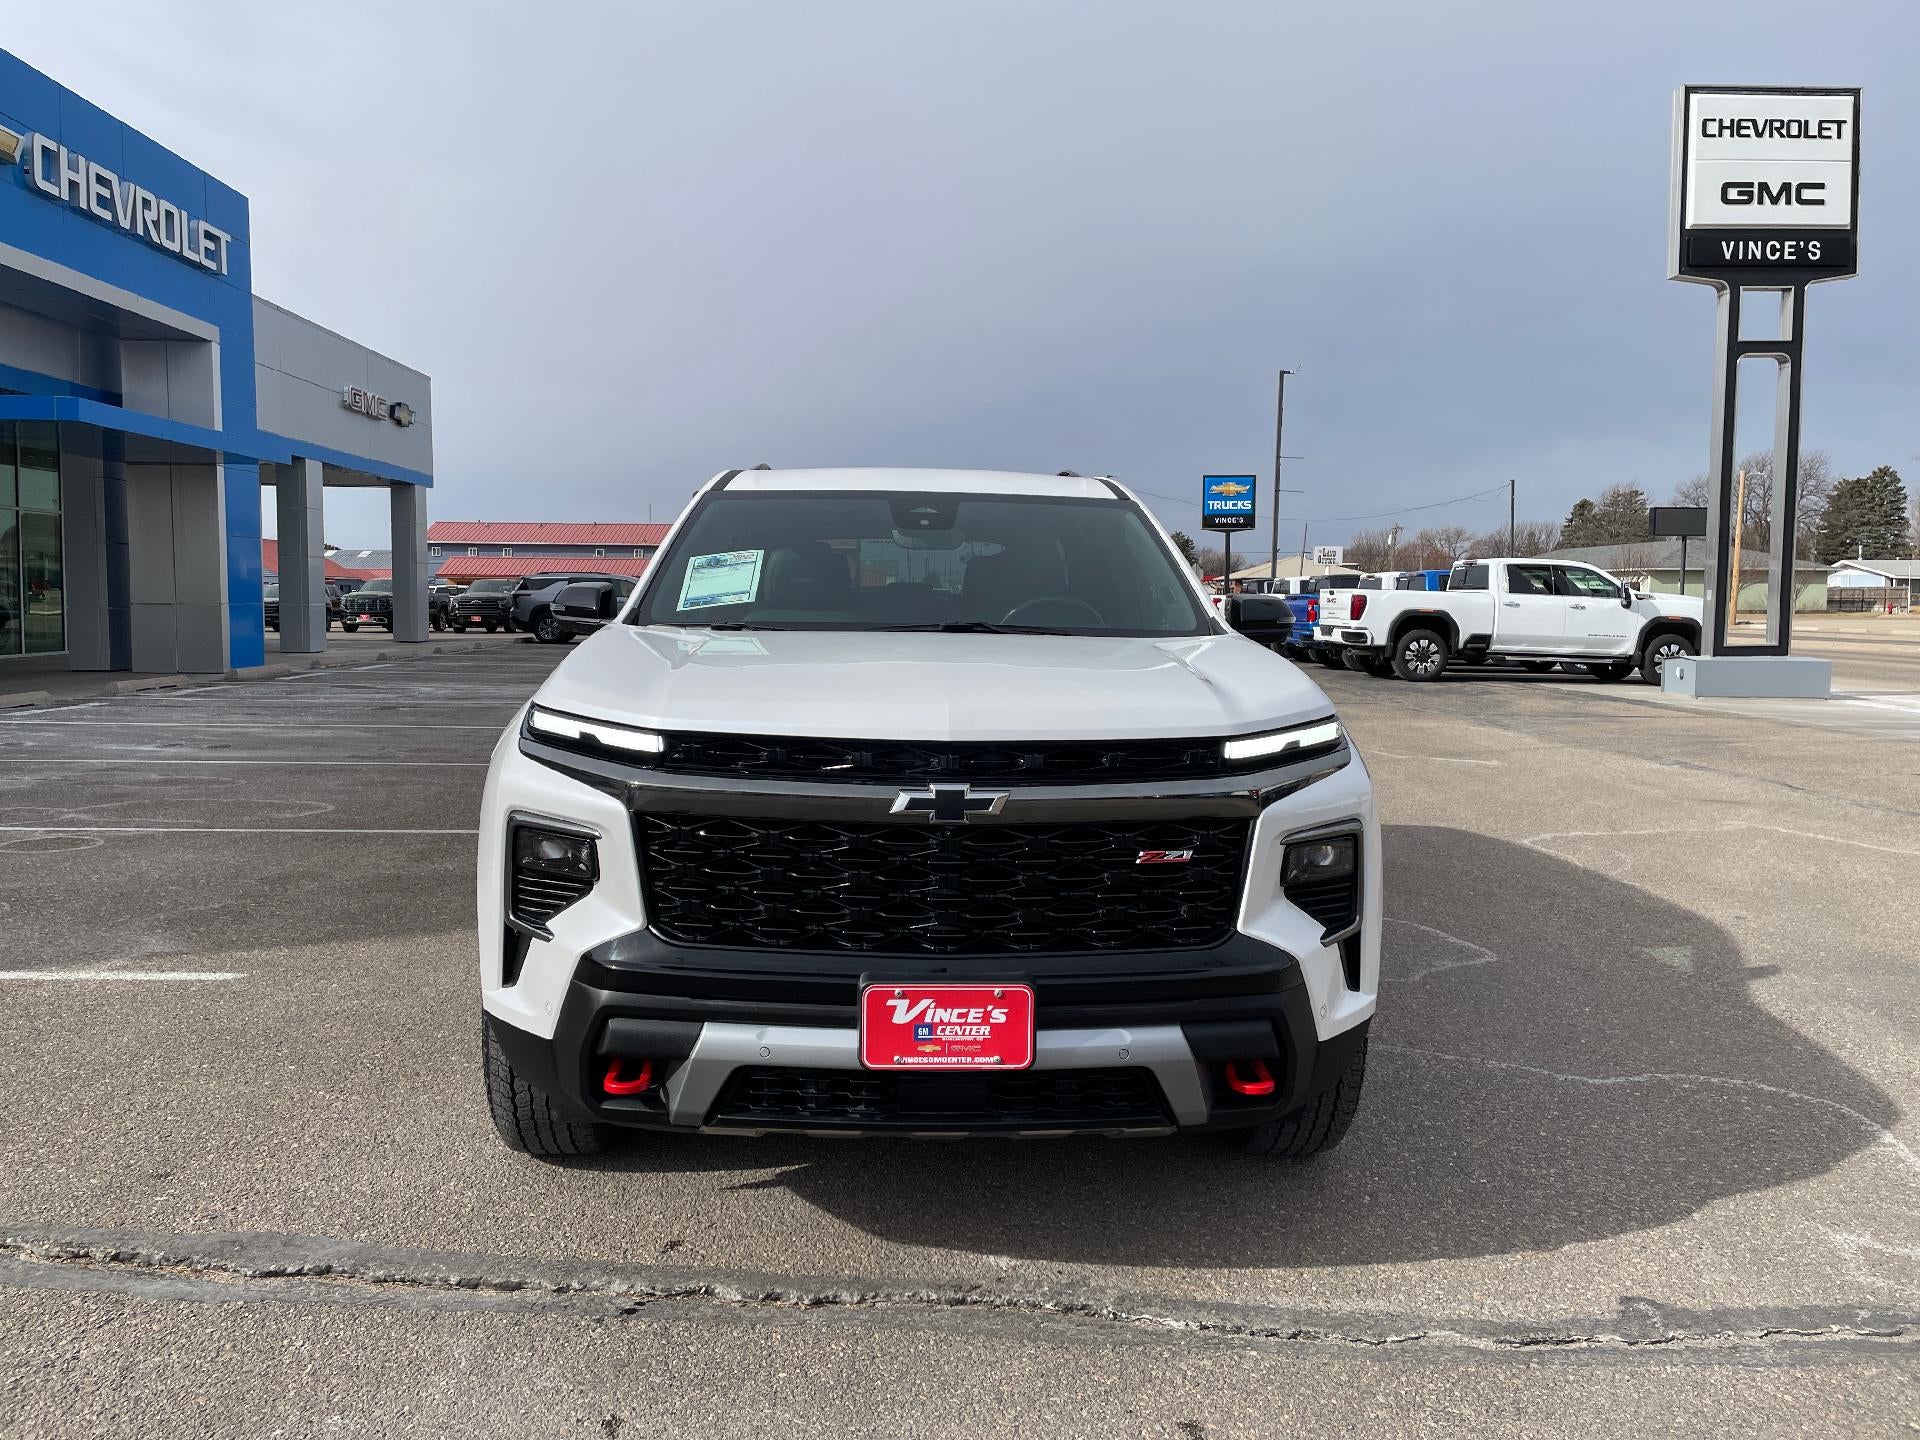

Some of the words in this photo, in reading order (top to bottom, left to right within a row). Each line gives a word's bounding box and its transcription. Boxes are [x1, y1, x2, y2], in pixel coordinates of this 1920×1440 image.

[1701, 118, 1848, 139] CHEVROLET
[30, 132, 231, 276] CHEVROLET
[1720, 181, 1826, 206] GMC
[1721, 240, 1821, 261] VINCE'S
[347, 384, 389, 421] GMC
[1207, 500, 1252, 510] TRUCKS
[1135, 850, 1194, 864] Z71
[917, 1027, 929, 1036] GM
[936, 1025, 991, 1036] CENTER
